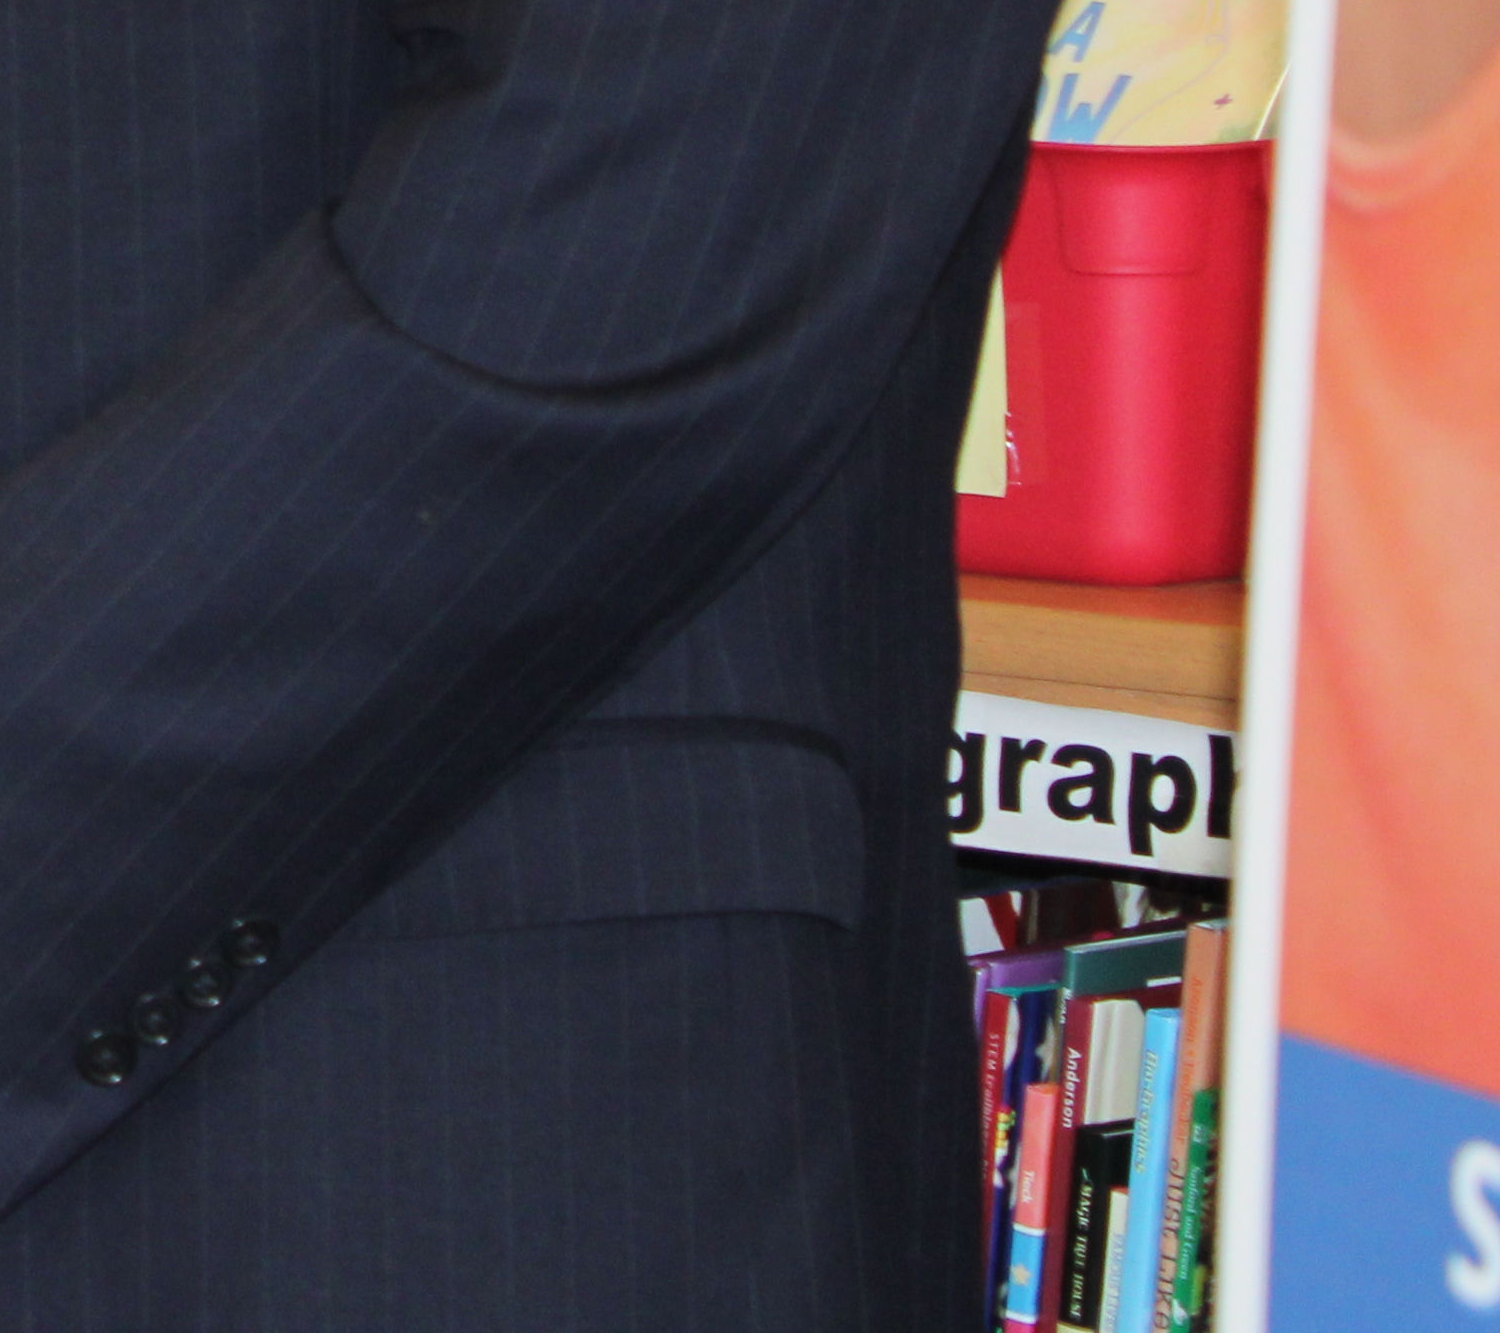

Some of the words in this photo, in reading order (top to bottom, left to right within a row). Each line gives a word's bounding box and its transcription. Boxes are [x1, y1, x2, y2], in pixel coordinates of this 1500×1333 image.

[1060, 1046, 1083, 1130] Anderson
[1019, 1168, 1038, 1205] Tieck
[1075, 1185, 1093, 1232] MAGIC
[1069, 1273, 1087, 1323] HOUSE
